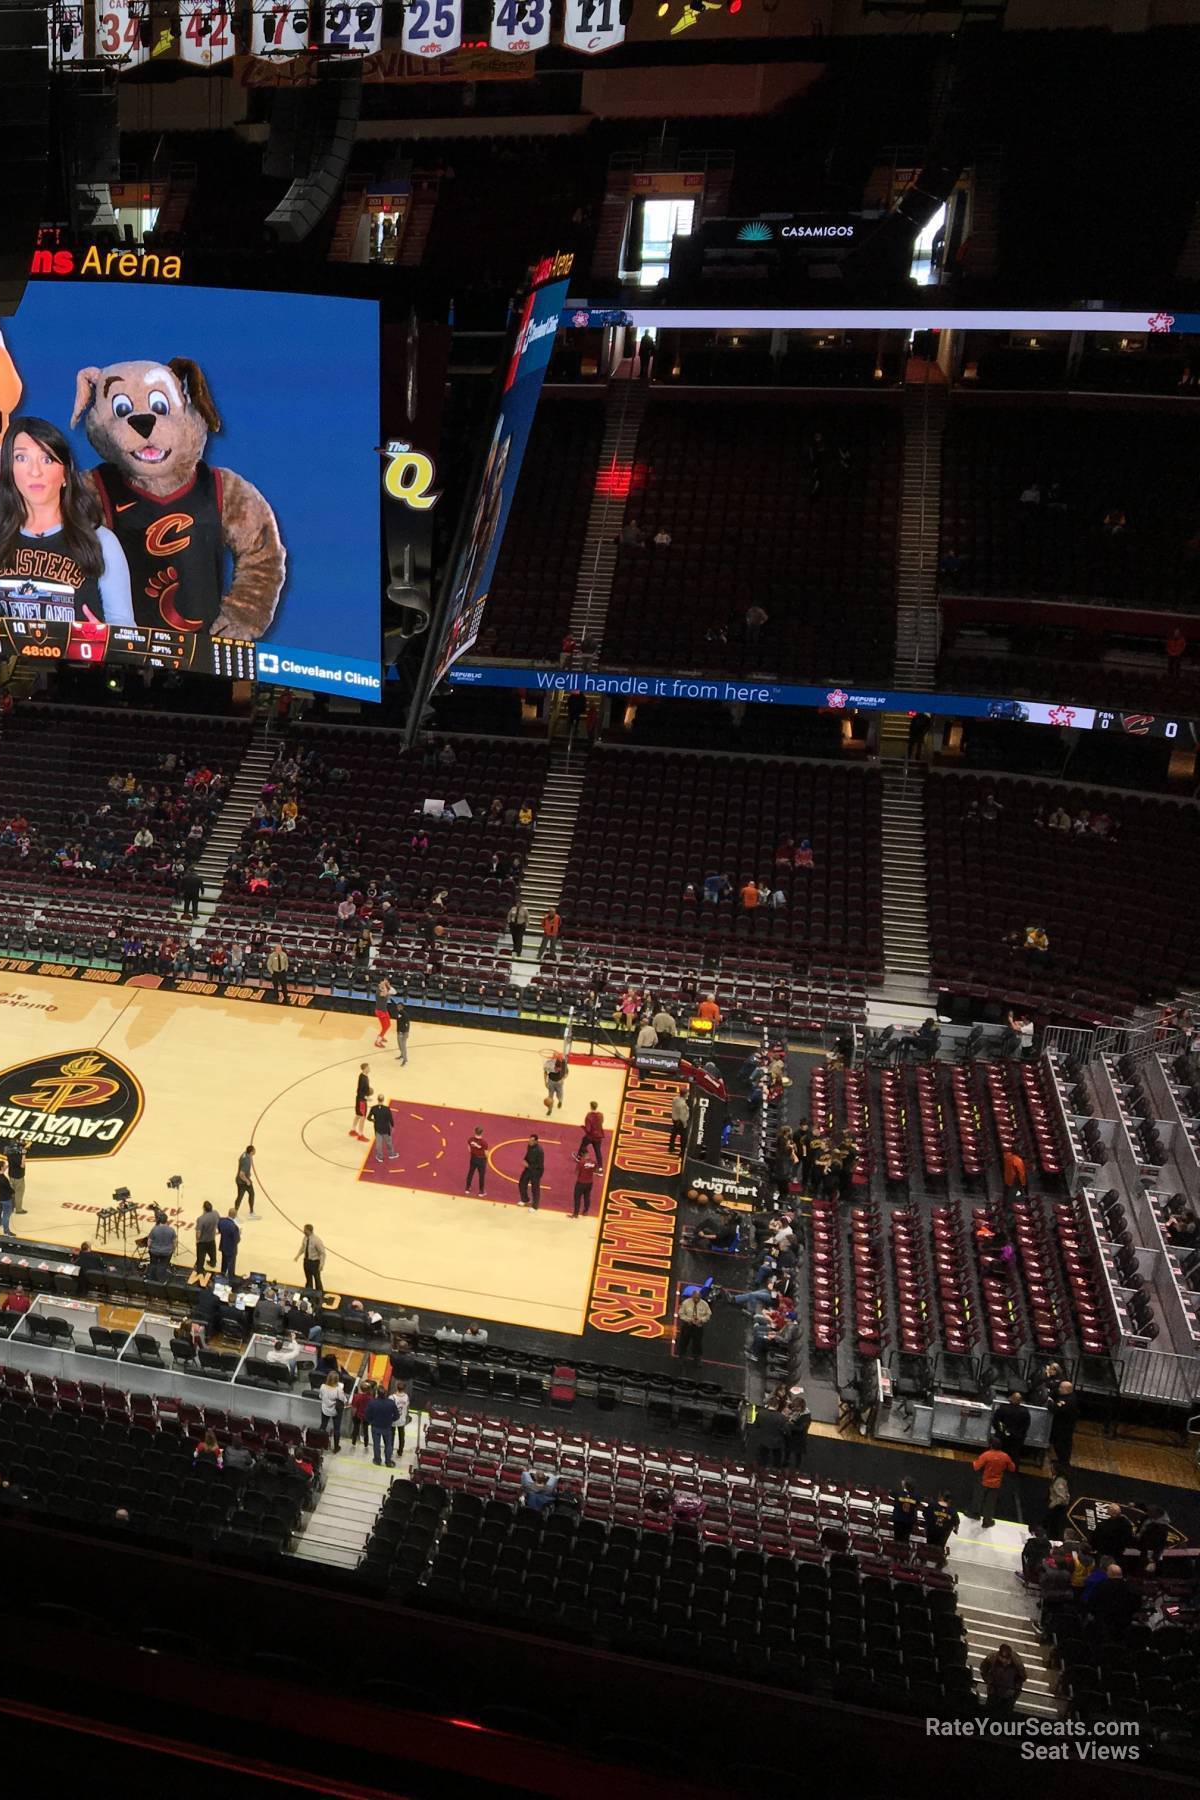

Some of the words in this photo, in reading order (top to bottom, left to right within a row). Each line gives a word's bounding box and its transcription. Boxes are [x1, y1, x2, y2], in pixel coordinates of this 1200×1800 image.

[186, 8, 228, 47] 42
[330, 6, 375, 43] 22
[408, 0, 455, 39] 25
[496, 0, 545, 36] 43
[576, 0, 614, 32] 11
[101, 13, 141, 51] 34
[781, 226, 854, 237] CASAMIGOS
[81, 245, 182, 279] Arena
[388, 441, 410, 452] The
[385, 452, 438, 508] Q
[13, 622, 26, 633] 1Q
[21, 645, 61, 657] 48:00
[80, 643, 92, 659] 0
[281, 660, 342, 681] Cleveland
[344, 671, 380, 688] Clinic
[536, 672, 578, 690] We'll
[585, 674, 649, 694] handle
[654, 679, 667, 696] it
[672, 680, 718, 699] from
[849, 695, 886, 704] REPUBLIC
[1101, 719, 1109, 729] 0
[1165, 722, 1178, 738] 0
[38, 963, 79, 978] FOR
[80, 968, 122, 983] ONE
[224, 986, 265, 1001] FOR
[615, 1066, 690, 1177] EVELAND
[692, 1178, 723, 1194] drug
[725, 1184, 758, 1197] mart
[588, 1189, 678, 1338] CAVALIERS
